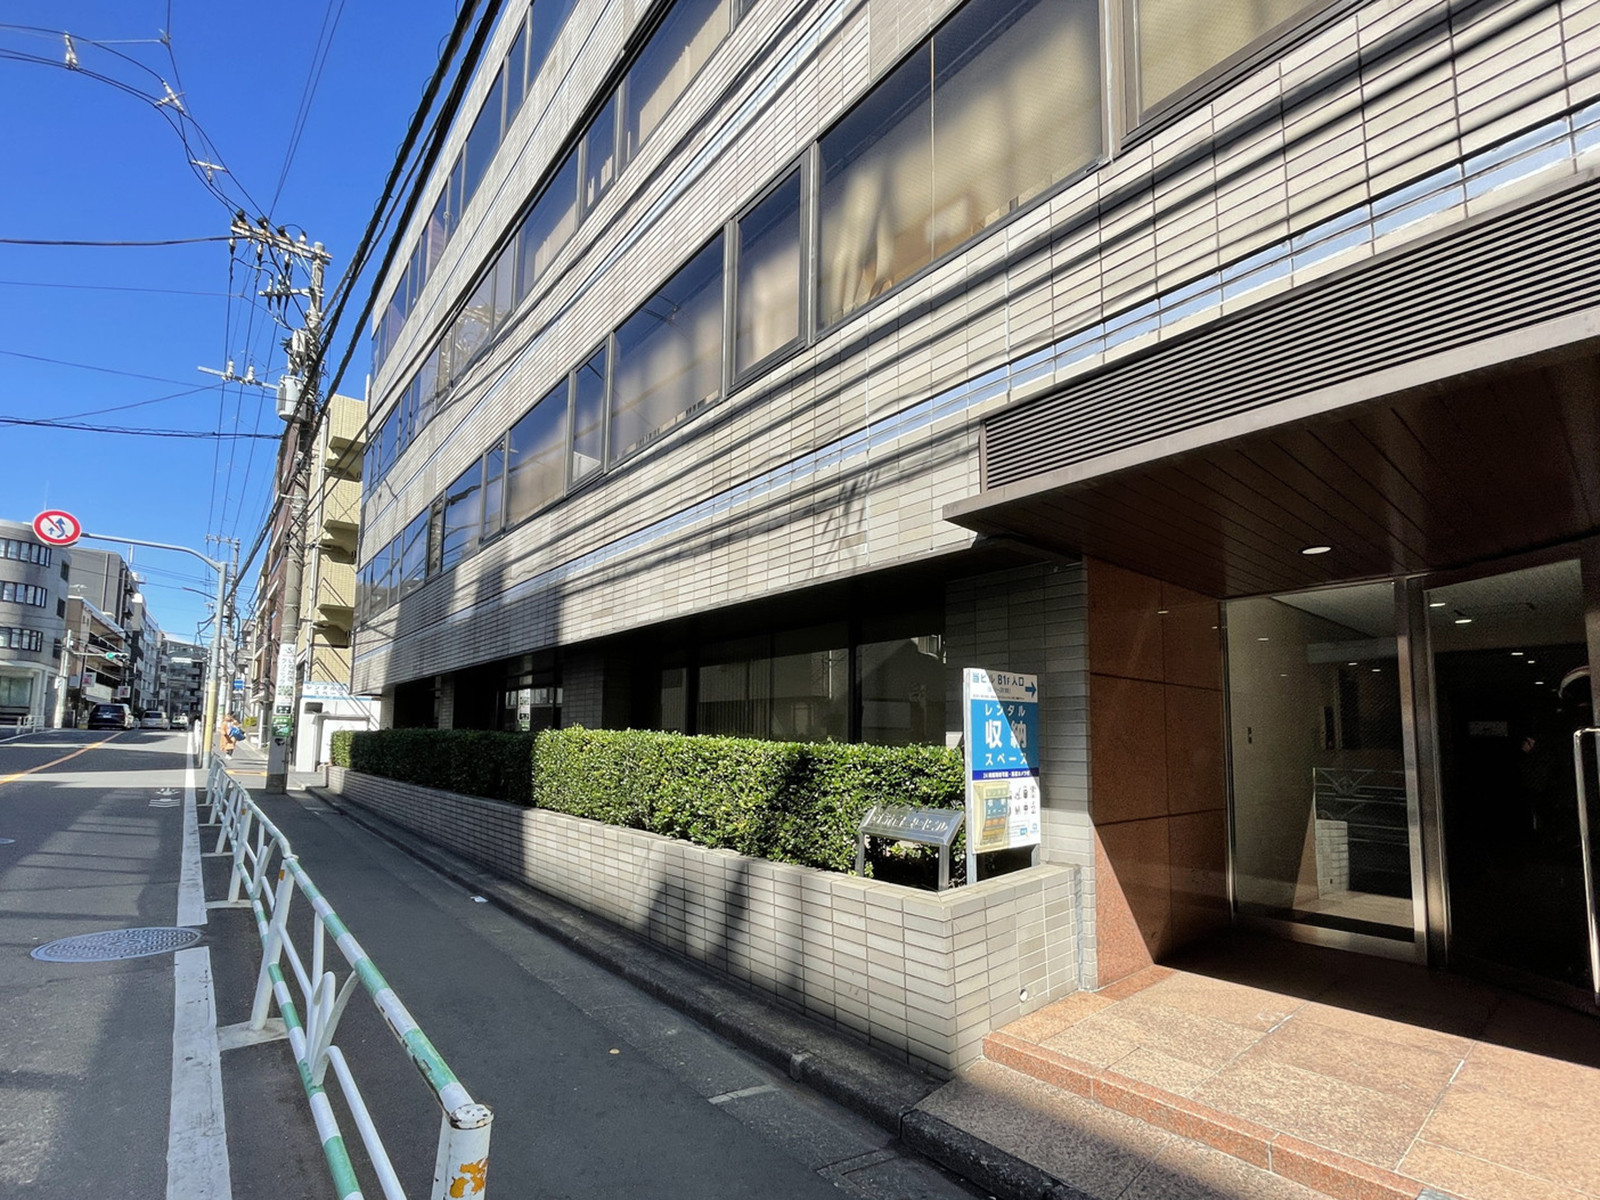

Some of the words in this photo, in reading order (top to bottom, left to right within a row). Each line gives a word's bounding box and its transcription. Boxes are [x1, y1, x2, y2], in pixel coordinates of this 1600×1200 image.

[1012, 676, 1024, 687] 入口
[985, 703, 1026, 717] レンタル
[985, 719, 1027, 749] 収納
[985, 753, 1028, 766] スペース
